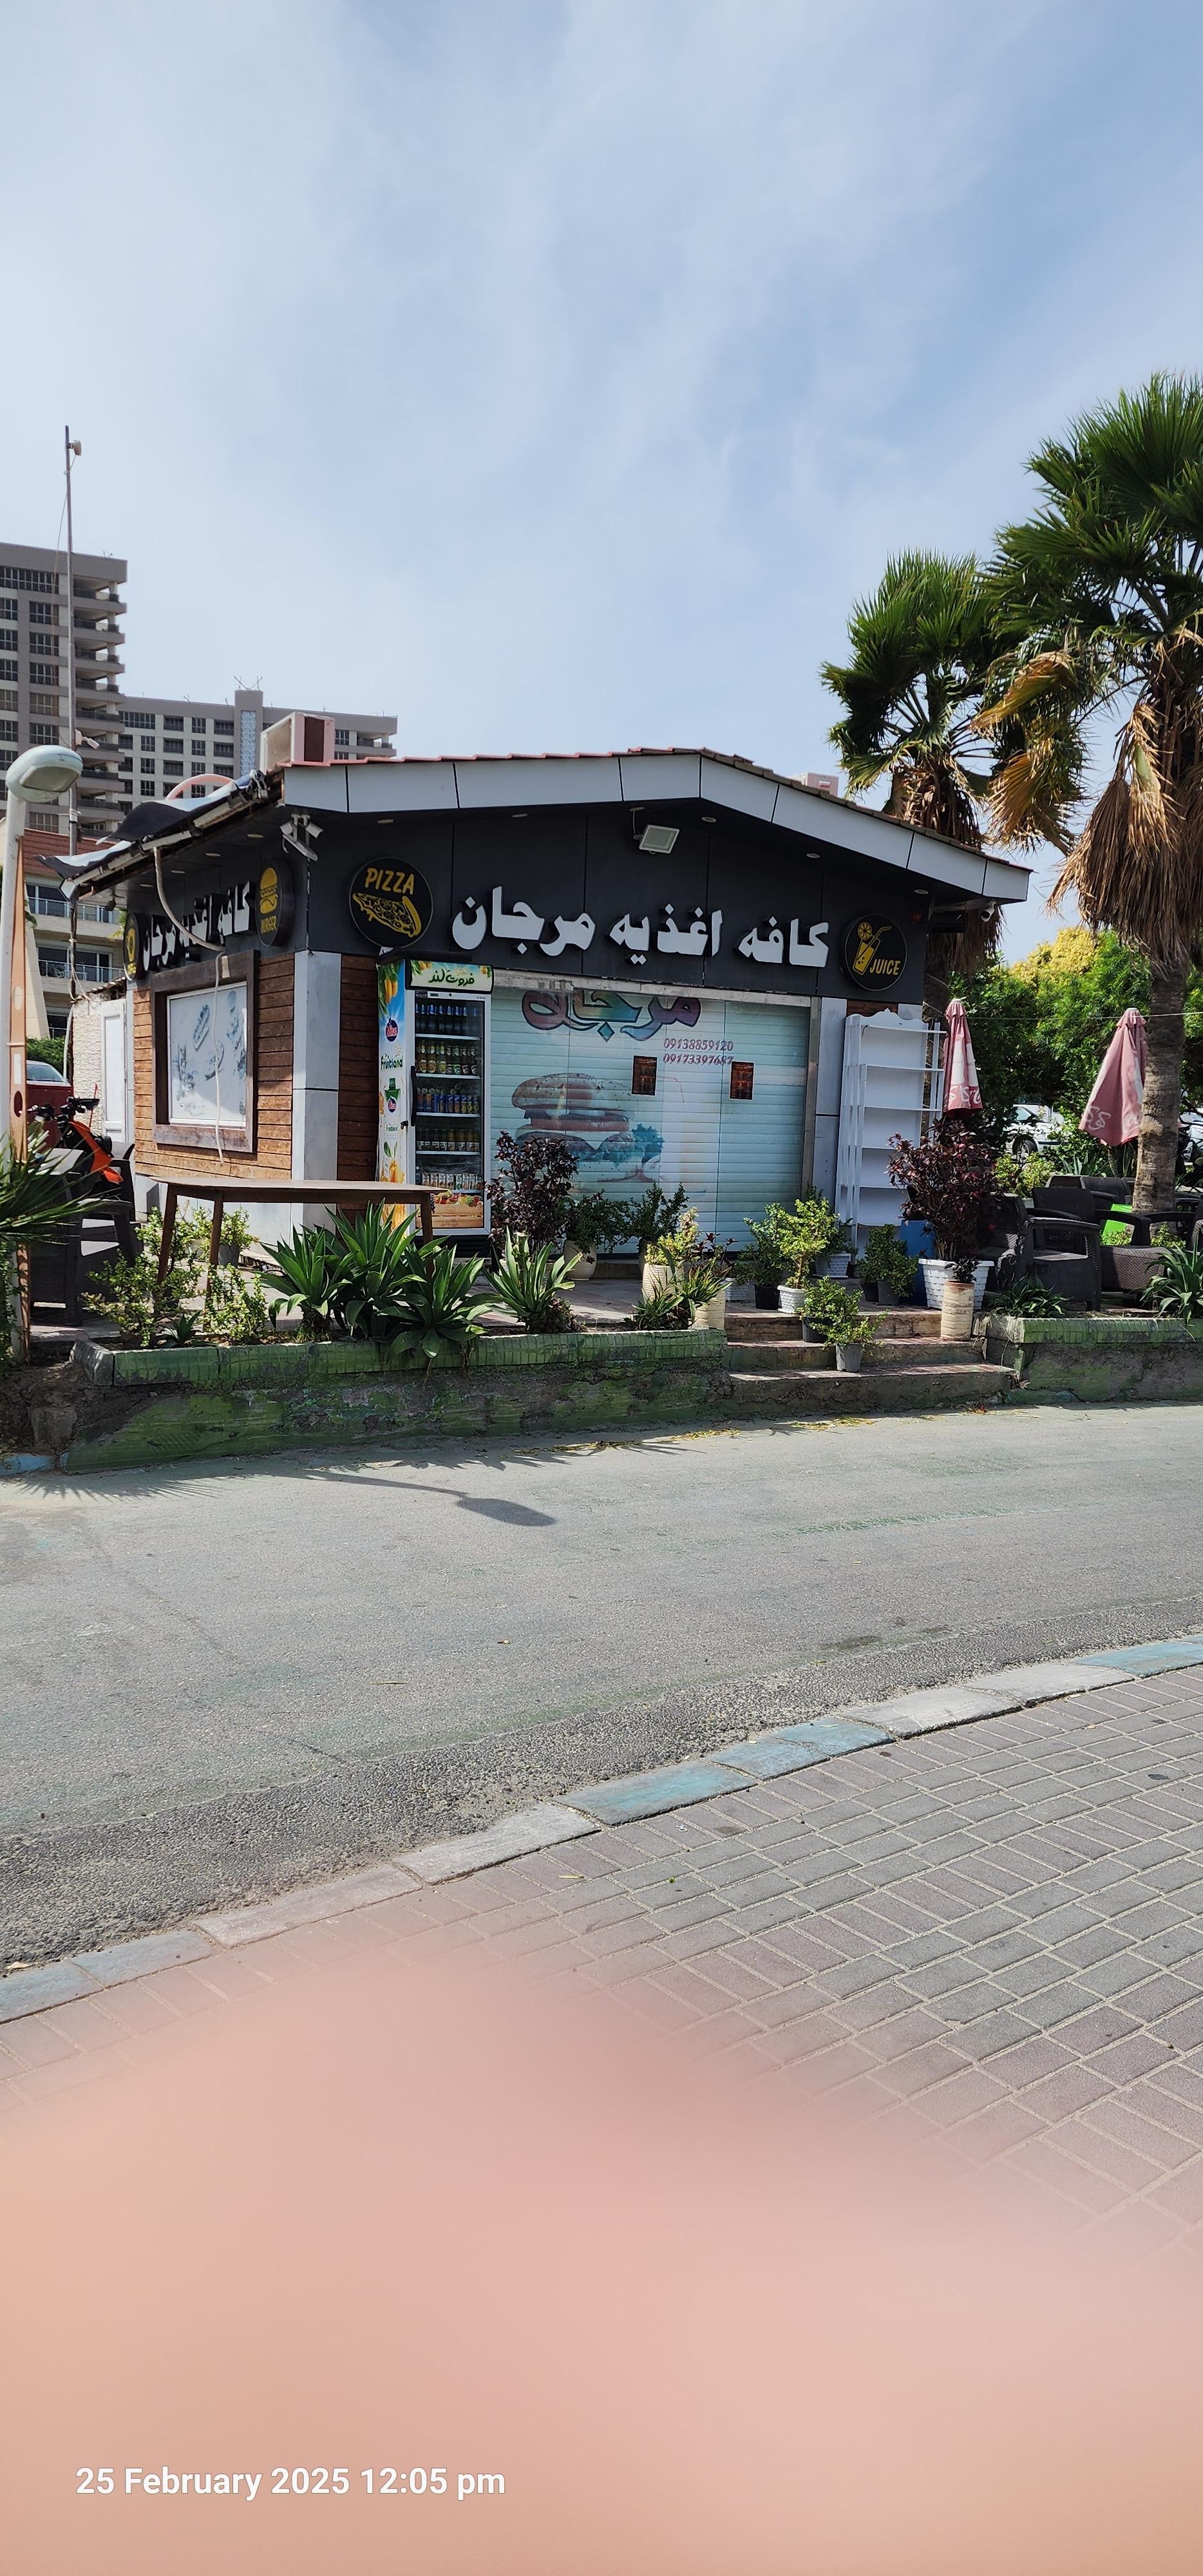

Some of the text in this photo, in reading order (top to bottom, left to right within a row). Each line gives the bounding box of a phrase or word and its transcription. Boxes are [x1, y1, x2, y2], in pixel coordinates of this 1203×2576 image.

[365, 867, 414, 895] PIZZA
[451, 886, 829, 967] کافه اغذیه مرجان
[869, 958, 901, 975] JUICE
[663, 1037, 734, 1051] 09138859120
